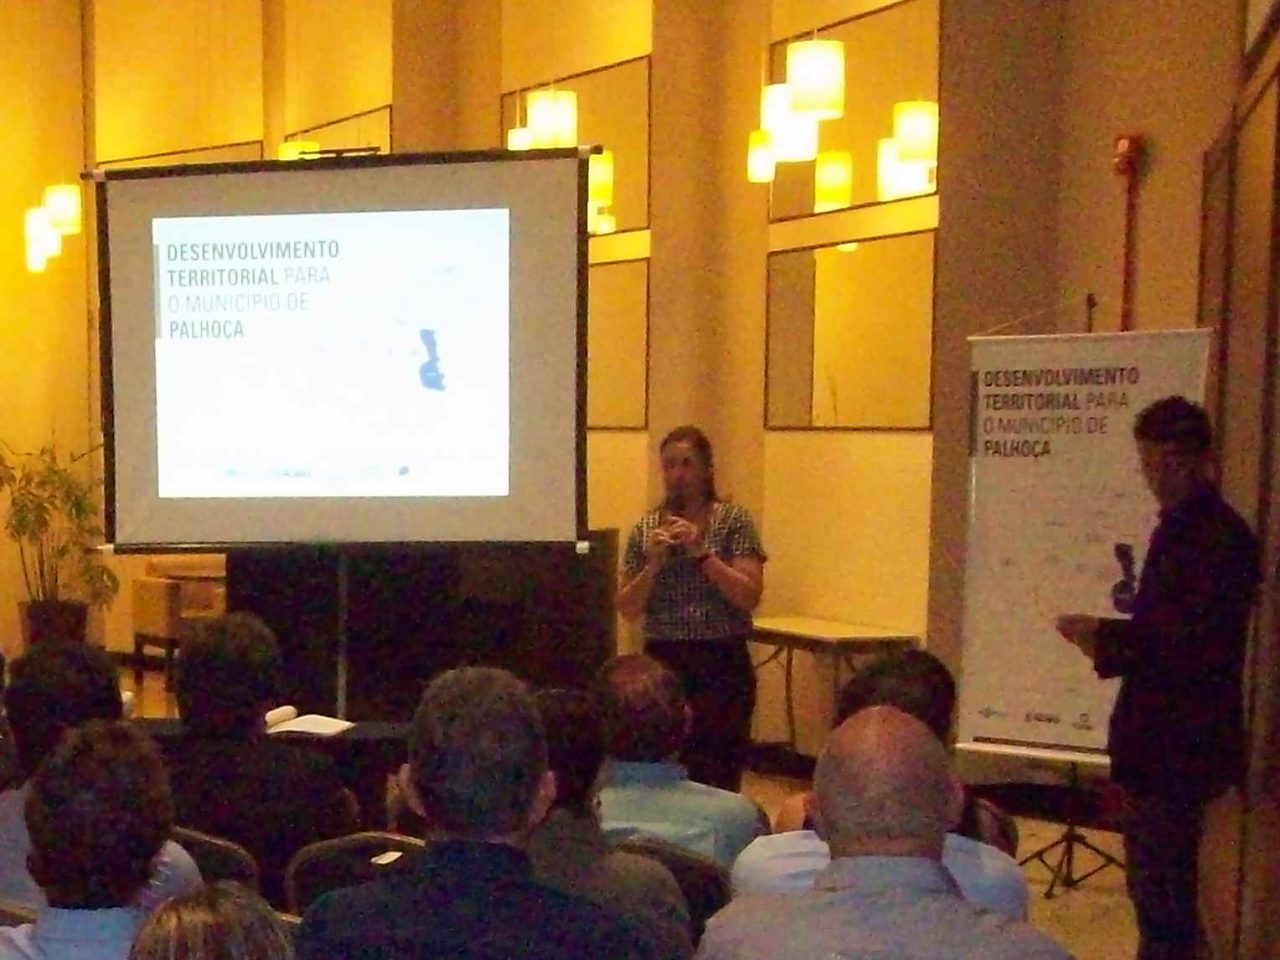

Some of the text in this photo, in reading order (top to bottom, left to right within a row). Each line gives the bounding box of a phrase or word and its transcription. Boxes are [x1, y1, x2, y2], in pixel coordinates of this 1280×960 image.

[167, 240, 340, 262] DESENVOLVIMENTO
[167, 266, 332, 287] TERRITORIAL PARA
[168, 294, 180, 314] O
[287, 292, 310, 311] DE
[169, 320, 244, 341] PALHOÇA
[983, 367, 1140, 388] DESENVOLVIMENTO
[983, 392, 1130, 411] TERRITORIAL PARA
[983, 416, 994, 435] O
[1087, 416, 1109, 434] DE
[984, 440, 1052, 458] PALHOÇA
